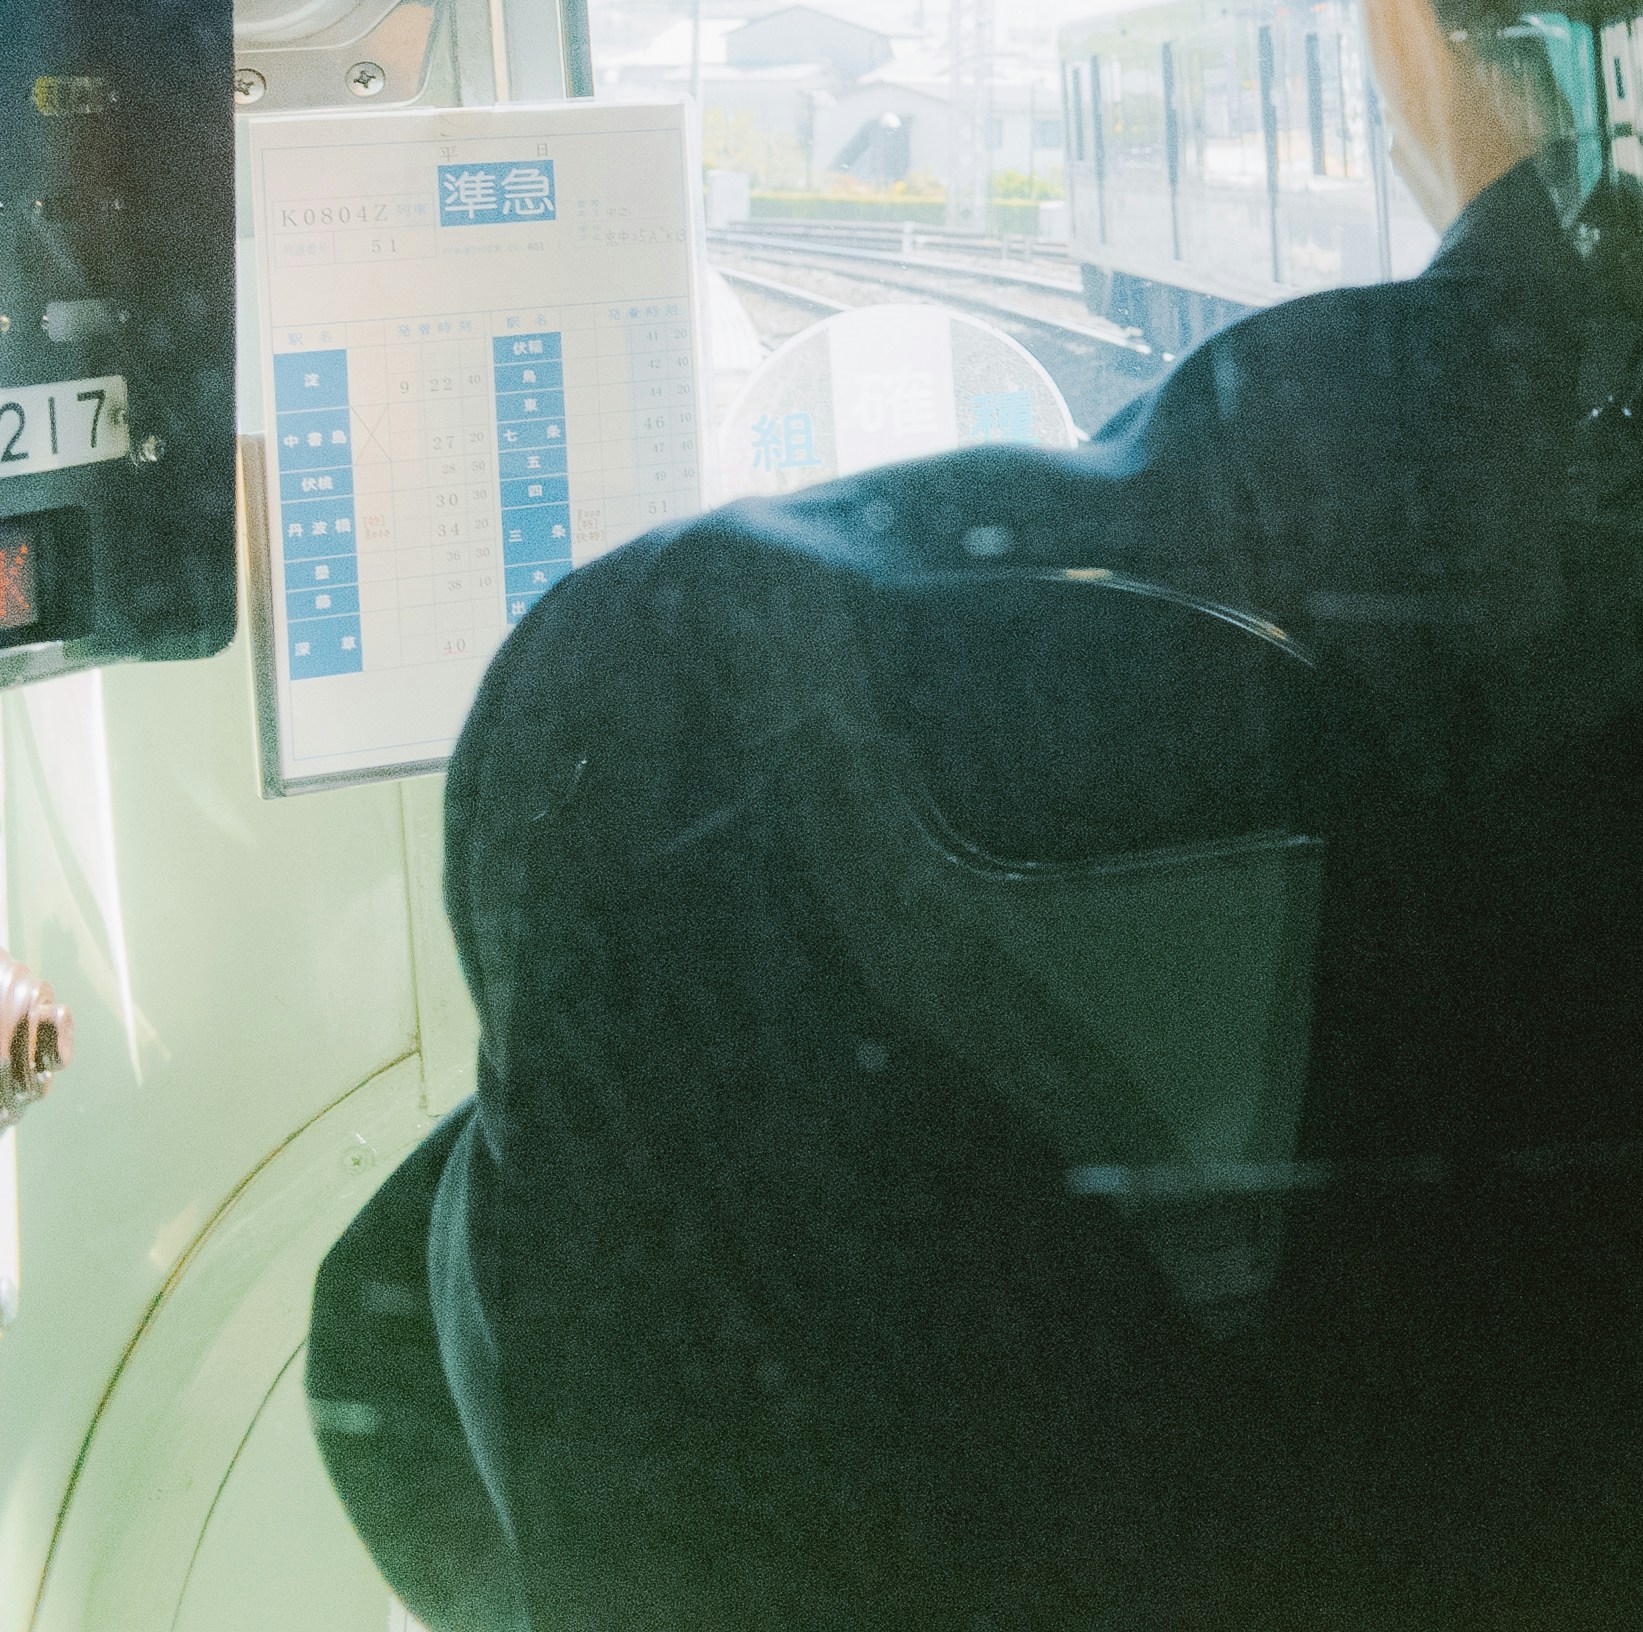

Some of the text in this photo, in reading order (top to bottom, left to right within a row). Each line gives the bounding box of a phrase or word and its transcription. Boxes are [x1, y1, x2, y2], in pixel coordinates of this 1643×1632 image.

[443, 168, 555, 220] 準急
[281, 204, 388, 227] K0804Z
[371, 238, 397, 254] 51
[400, 373, 482, 394] 9 22 40
[644, 416, 665, 430] 46
[432, 431, 485, 451] 27 20
[751, 413, 823, 473] 組
[441, 463, 456, 475] 28
[436, 488, 488, 509] 30 30
[648, 500, 668, 515] 51
[287, 518, 490, 538] 丹波橋 34 20
[478, 575, 493, 588] 10
[443, 638, 467, 655] 40
